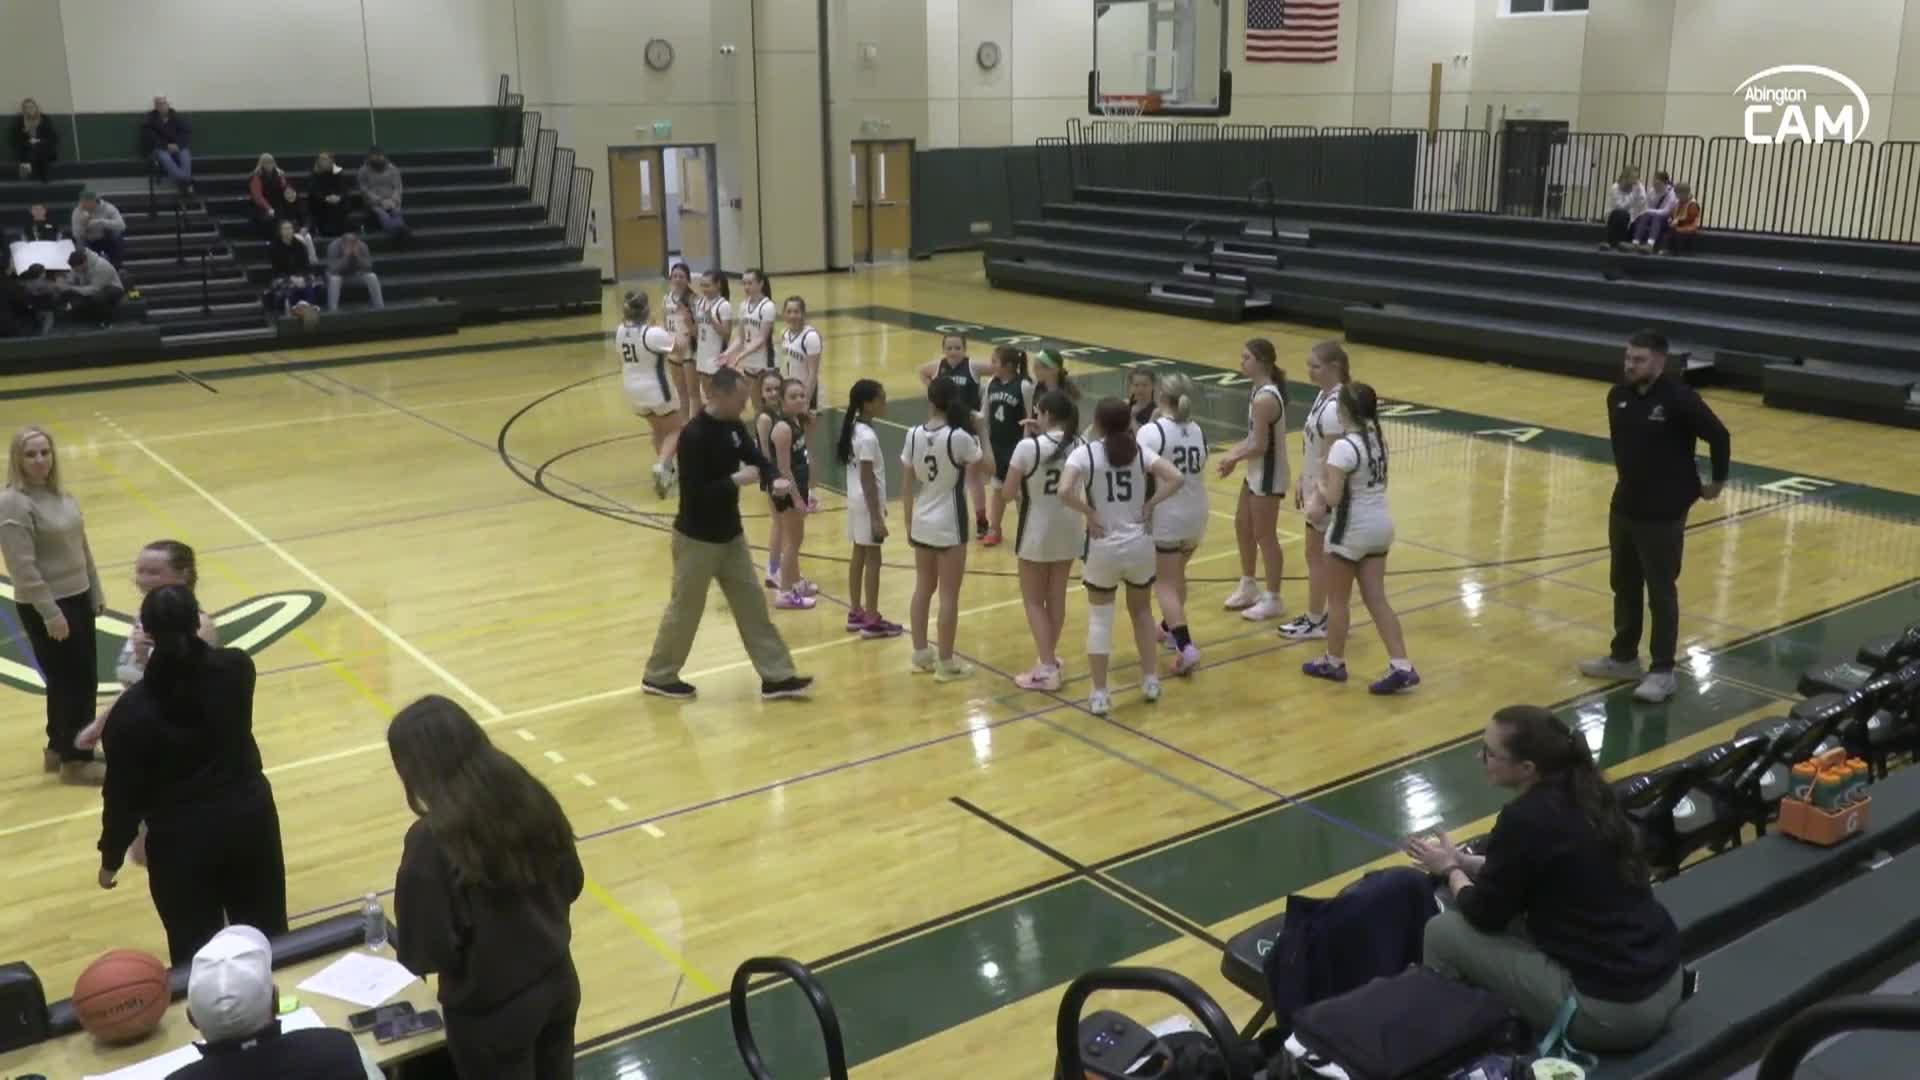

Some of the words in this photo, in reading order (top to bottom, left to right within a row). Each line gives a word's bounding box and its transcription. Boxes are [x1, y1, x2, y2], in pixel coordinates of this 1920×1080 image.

[621, 343, 639, 363] 21
[994, 404, 1005, 422] 4
[924, 455, 939, 482] 3
[1174, 445, 1202, 475] 20
[1105, 470, 1133, 503] 15
